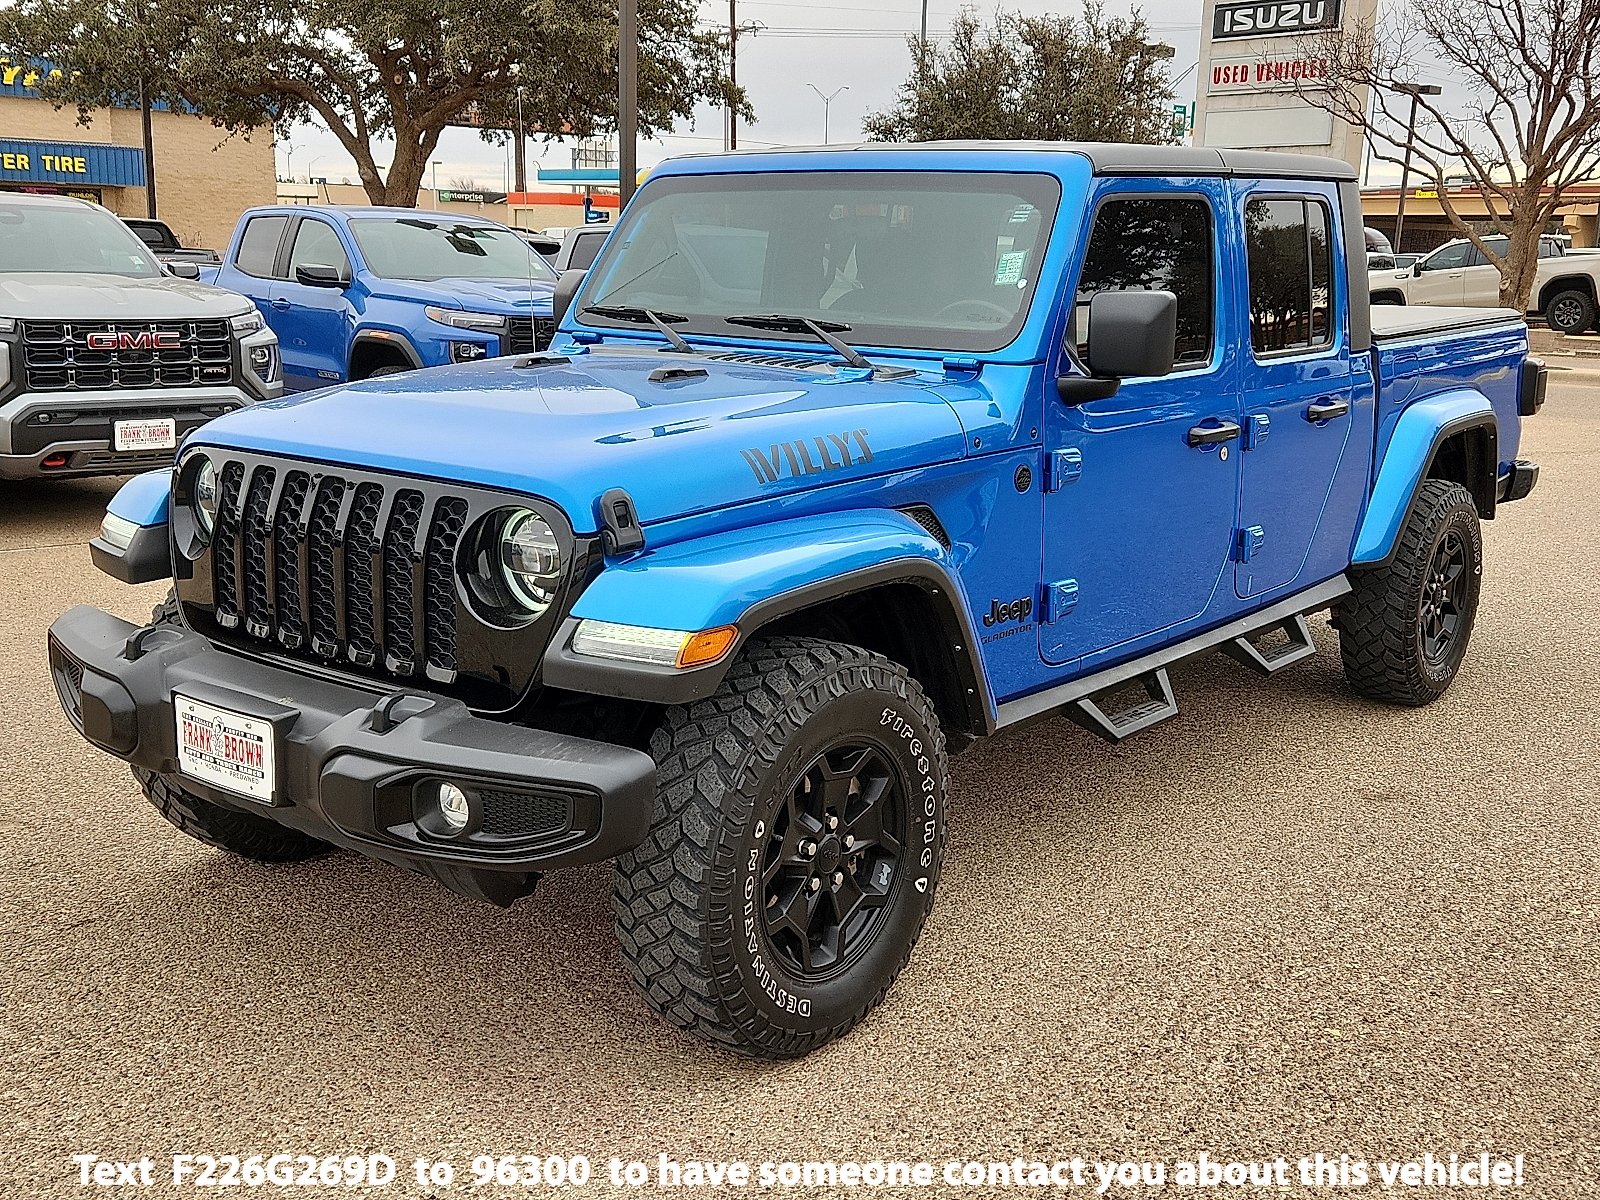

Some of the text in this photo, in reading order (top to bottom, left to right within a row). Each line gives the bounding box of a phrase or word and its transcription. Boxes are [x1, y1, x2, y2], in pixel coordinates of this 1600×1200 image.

[1223, 1, 1325, 33] ISUZU
[1213, 58, 1328, 85] USED VEHICLES
[0, 152, 86, 173] ER TIRE
[440, 192, 484, 202] enterprise
[87, 331, 181, 350] GMC
[120, 429, 142, 440] FRANK
[148, 427, 170, 438] BROWN
[740, 428, 874, 485] WILLYS
[982, 596, 1033, 628] Jeep
[980, 624, 1032, 646] GLADIATOR
[182, 720, 214, 755] FRANK
[224, 735, 264, 771] BROWN
[229, 770, 260, 785] PREOWNED
[879, 707, 937, 869] Firestone
[743, 849, 813, 1018] DESTINATION
